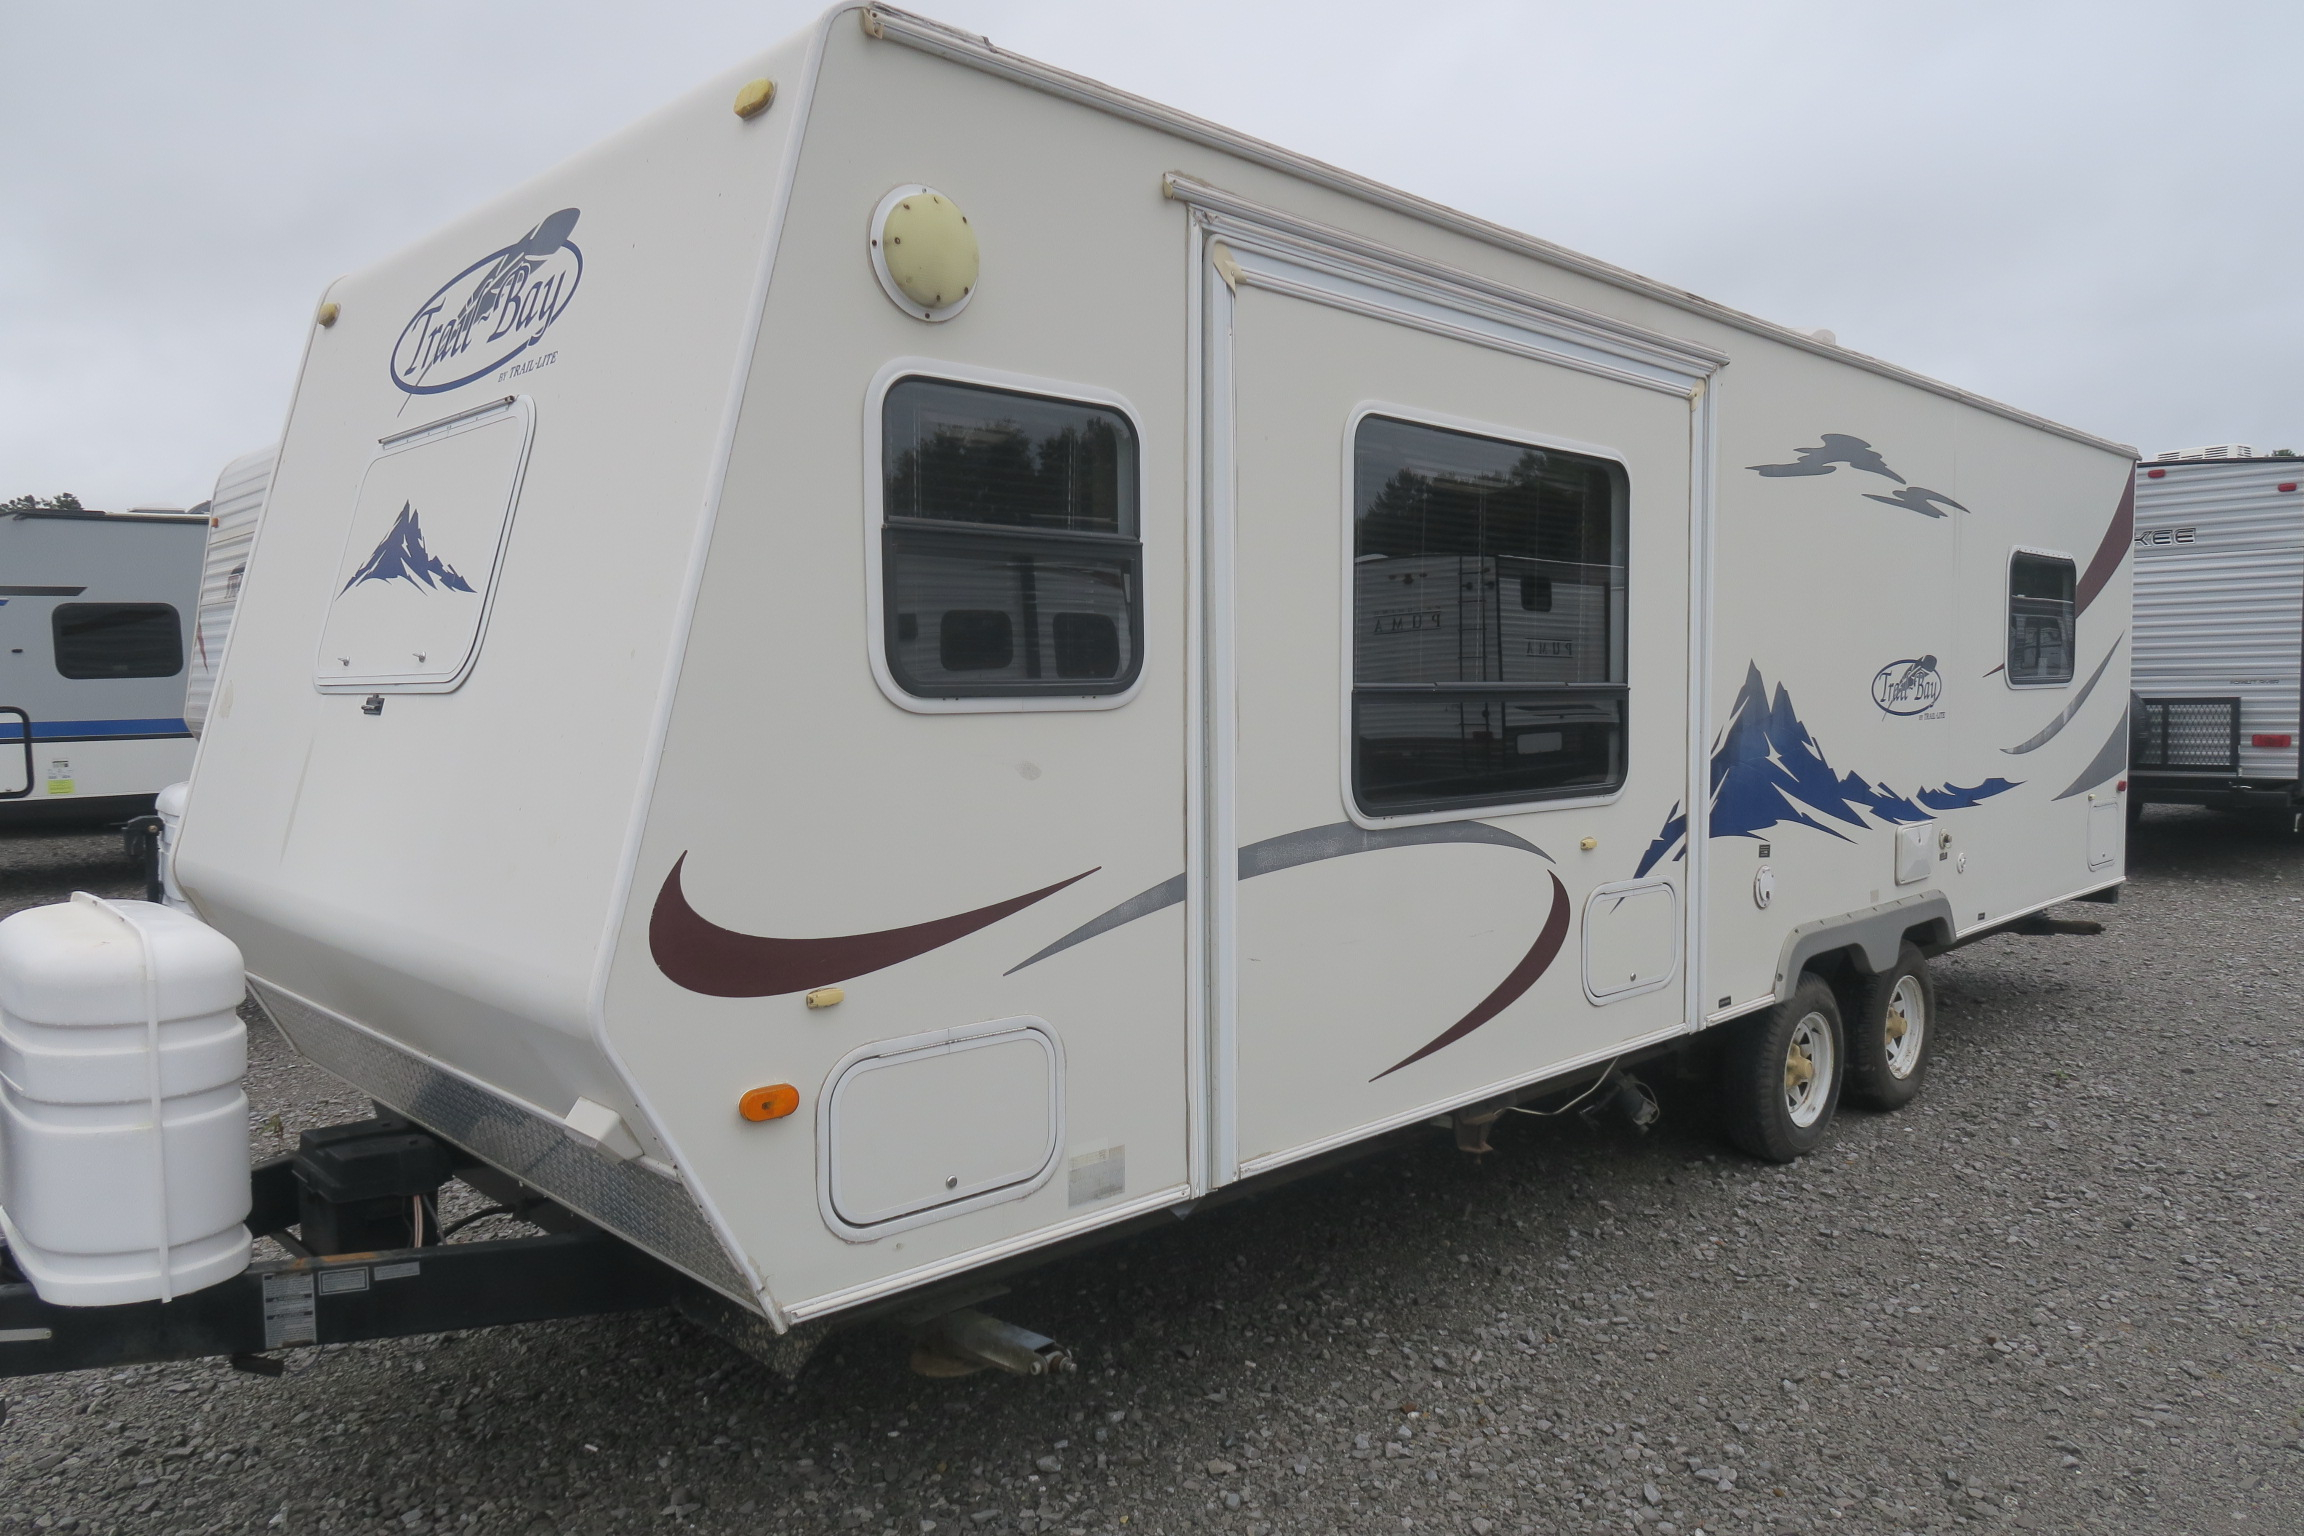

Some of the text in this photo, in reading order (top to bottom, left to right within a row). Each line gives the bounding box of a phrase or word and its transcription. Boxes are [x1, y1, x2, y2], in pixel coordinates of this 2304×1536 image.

[403, 264, 567, 377] Trail Bay
[1914, 671, 1937, 708] Bay
